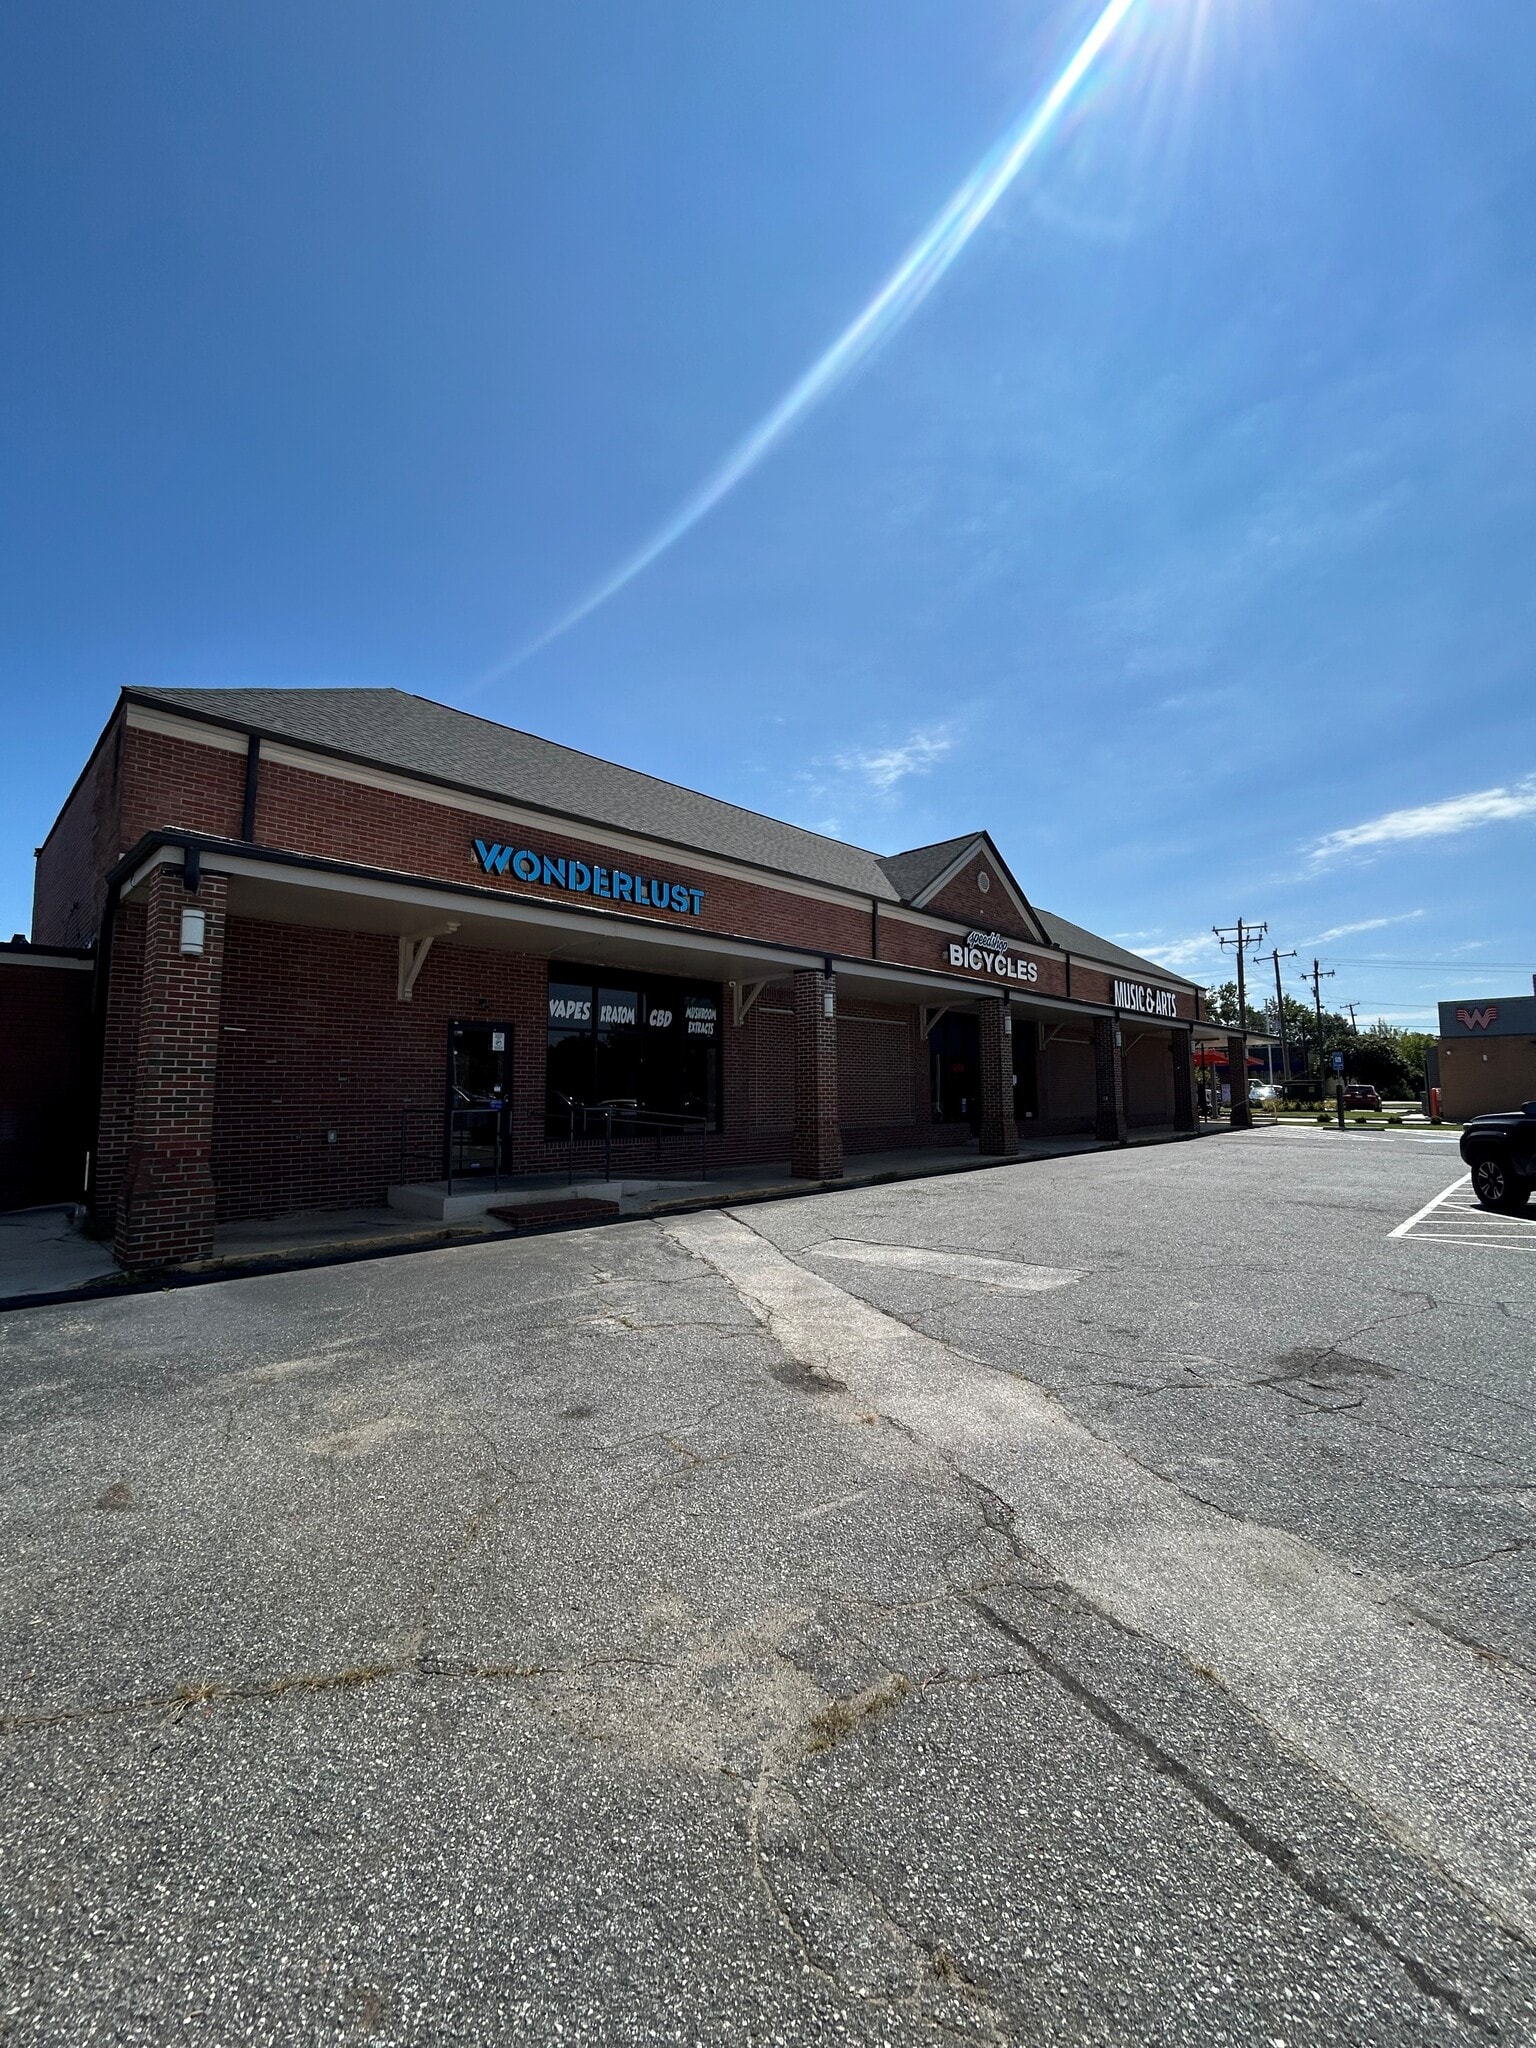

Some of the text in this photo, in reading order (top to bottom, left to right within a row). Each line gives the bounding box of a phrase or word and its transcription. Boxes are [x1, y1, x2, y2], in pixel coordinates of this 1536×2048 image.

[473, 838, 705, 916] WONDERLUST
[950, 944, 1037, 982] BICYCLES
[1114, 980, 1177, 1018] MUSIC & ARTS
[548, 999, 592, 1020] VAPES
[600, 1005, 635, 1025] KRATOM
[649, 1009, 673, 1028] CBD
[685, 1006, 717, 1021] MUSHROOM
[688, 1021, 714, 1035] EXTRACTS
